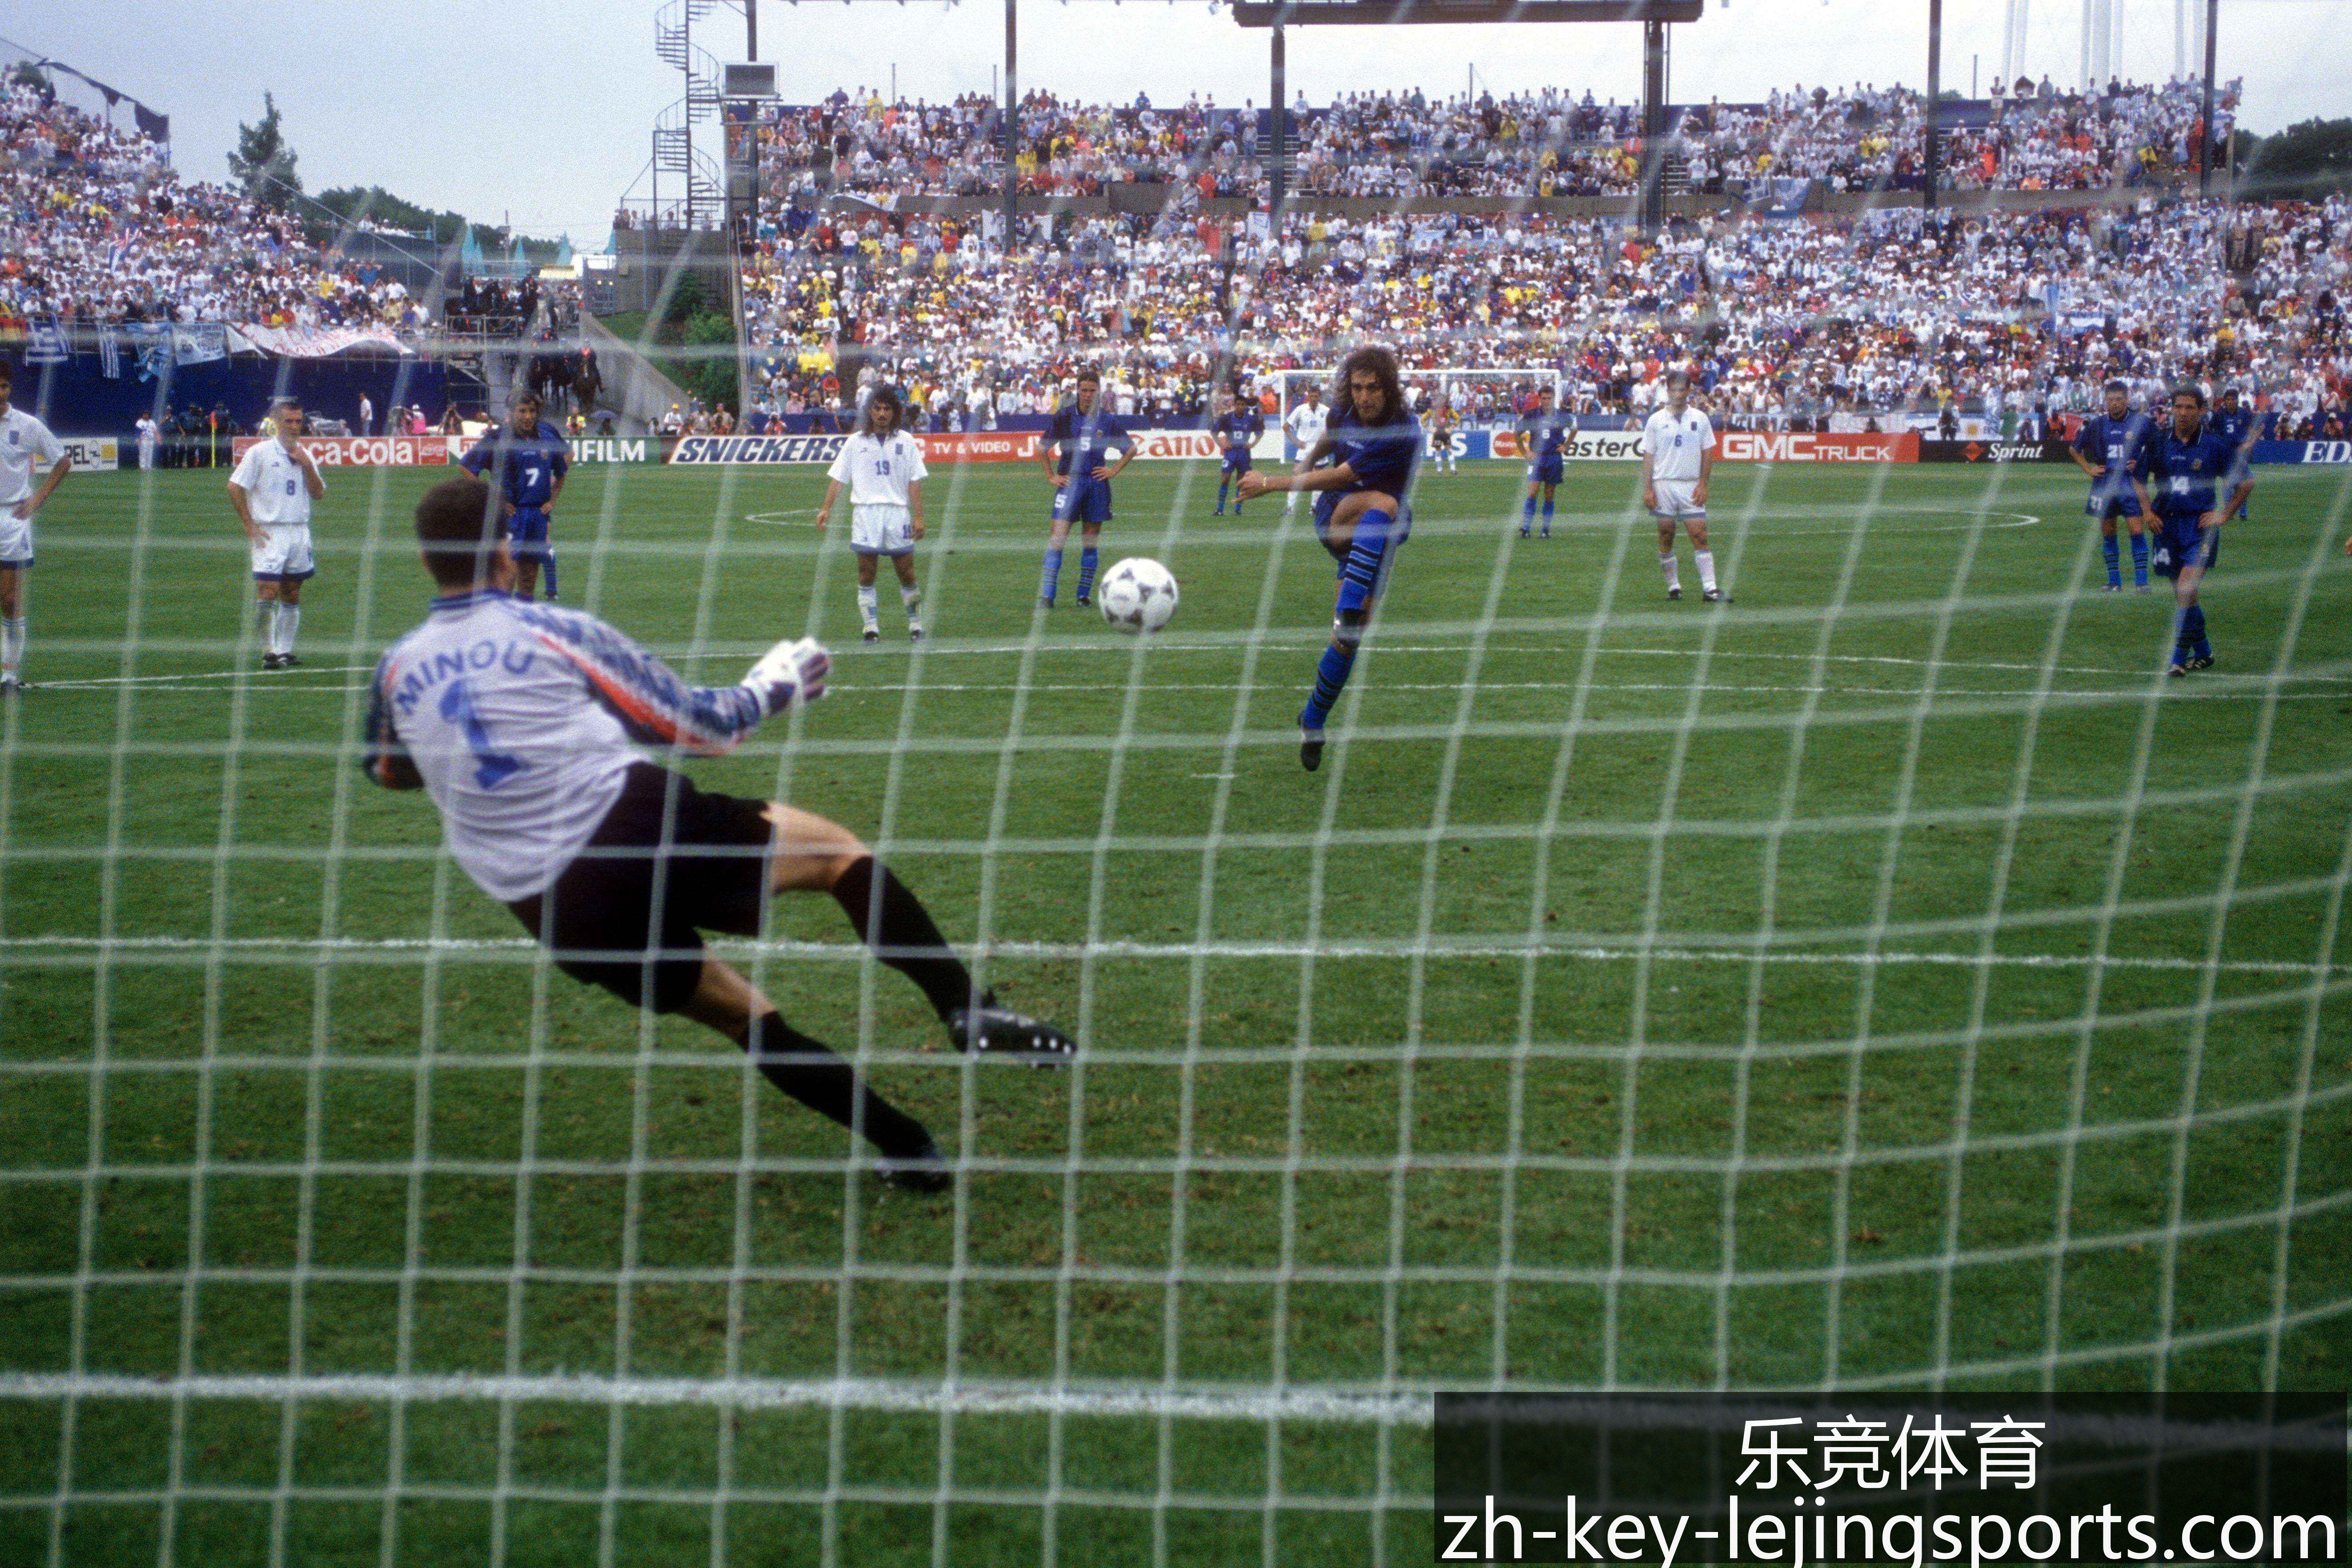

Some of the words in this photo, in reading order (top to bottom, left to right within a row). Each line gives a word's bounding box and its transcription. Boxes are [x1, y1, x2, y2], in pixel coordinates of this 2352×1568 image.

[2226, 424, 2235, 433] 3
[676, 437, 848, 462] SNICKERS
[933, 442, 951, 454] TV
[956, 442, 966, 454] &
[970, 441, 1011, 453] VIDEO
[1080, 437, 1091, 451] 5
[1674, 434, 1682, 447] 6
[1722, 434, 1817, 460] GMC
[1814, 446, 1891, 461] TRUCK
[64, 444, 90, 465] PEL
[308, 438, 413, 465] ca-Cola
[572, 439, 645, 462] IFILM
[1987, 442, 2043, 462] Sprint
[2107, 444, 2124, 458] 21
[2302, 441, 2352, 463] ED
[525, 467, 540, 486] 7
[875, 460, 890, 475] 19
[286, 479, 296, 496] 8
[1054, 493, 1067, 509] 5
[395, 640, 535, 713] MINOU
[440, 676, 520, 790] 1
